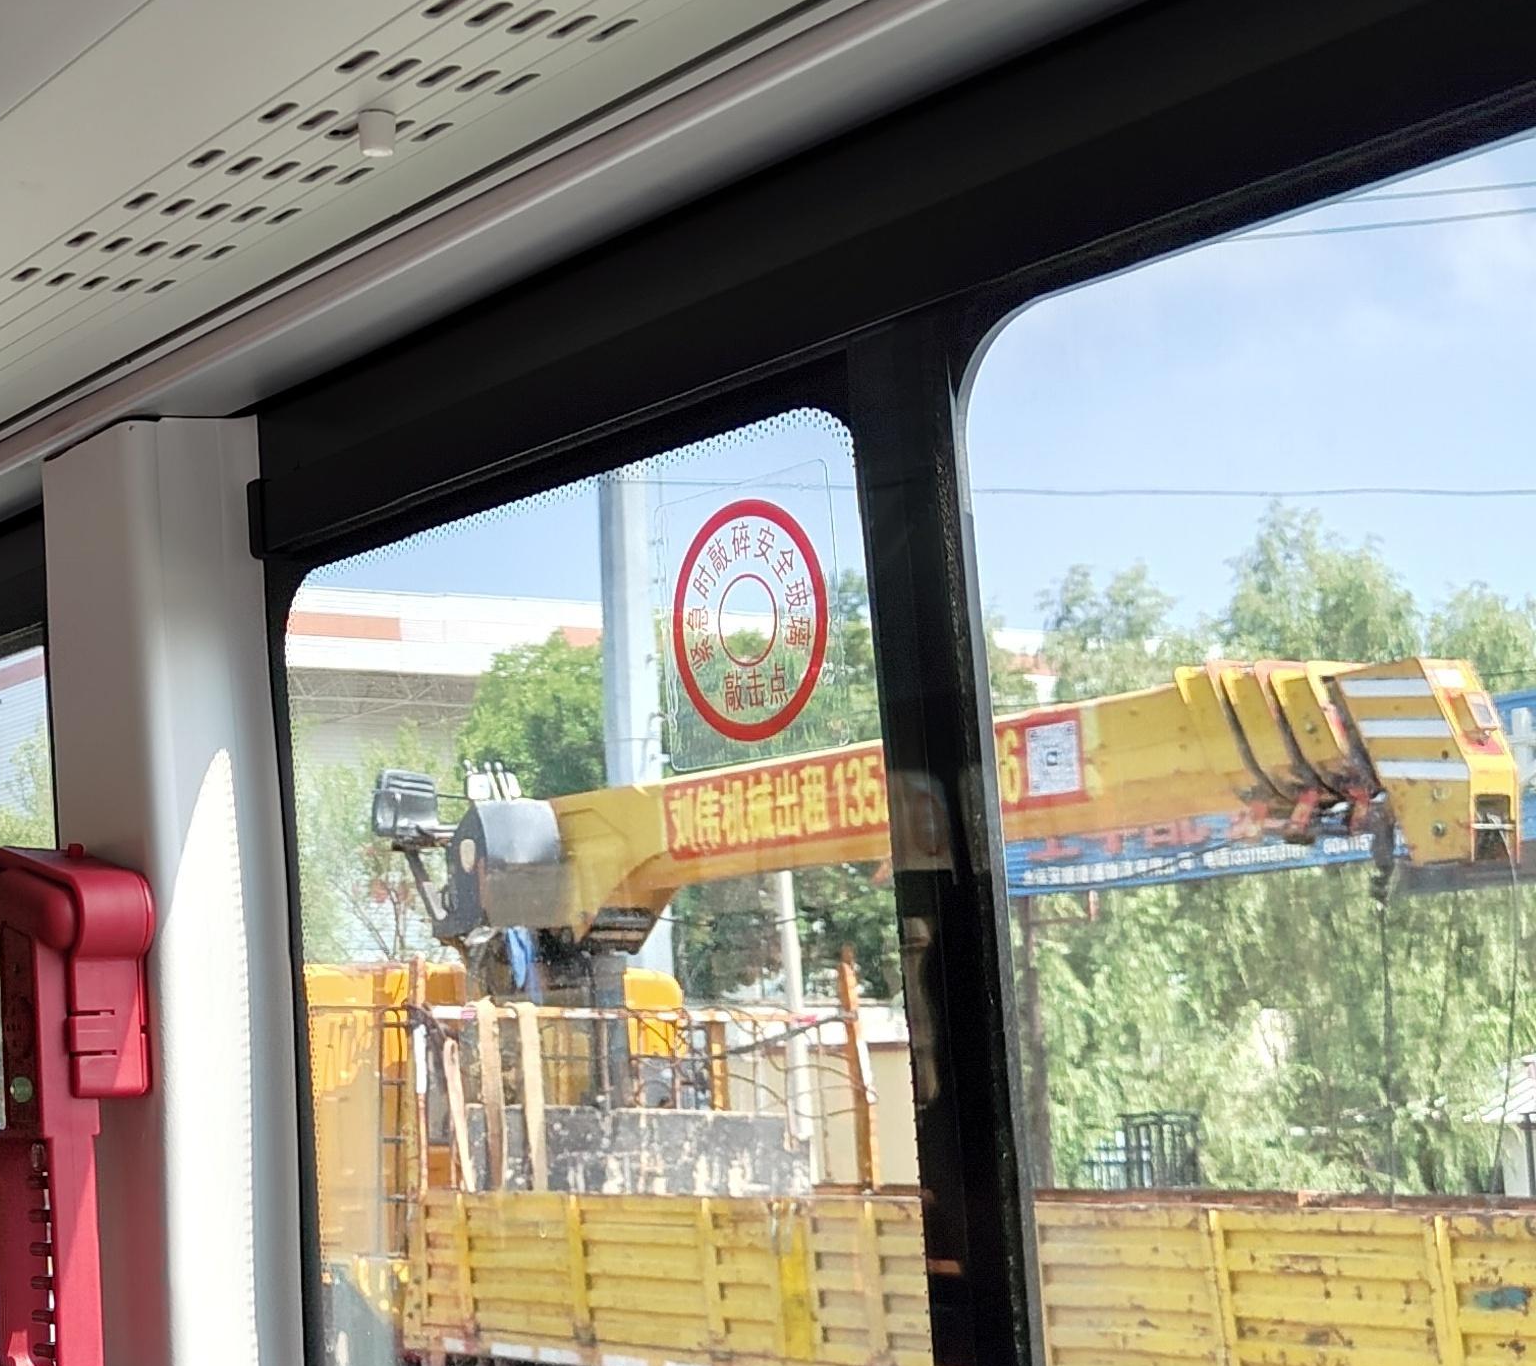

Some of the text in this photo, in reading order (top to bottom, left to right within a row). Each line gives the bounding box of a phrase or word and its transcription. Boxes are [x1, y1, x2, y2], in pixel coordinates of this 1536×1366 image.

[686, 521, 811, 669] 紧急时敲碎安全玻璃
[723, 663, 789, 713] 敲击点
